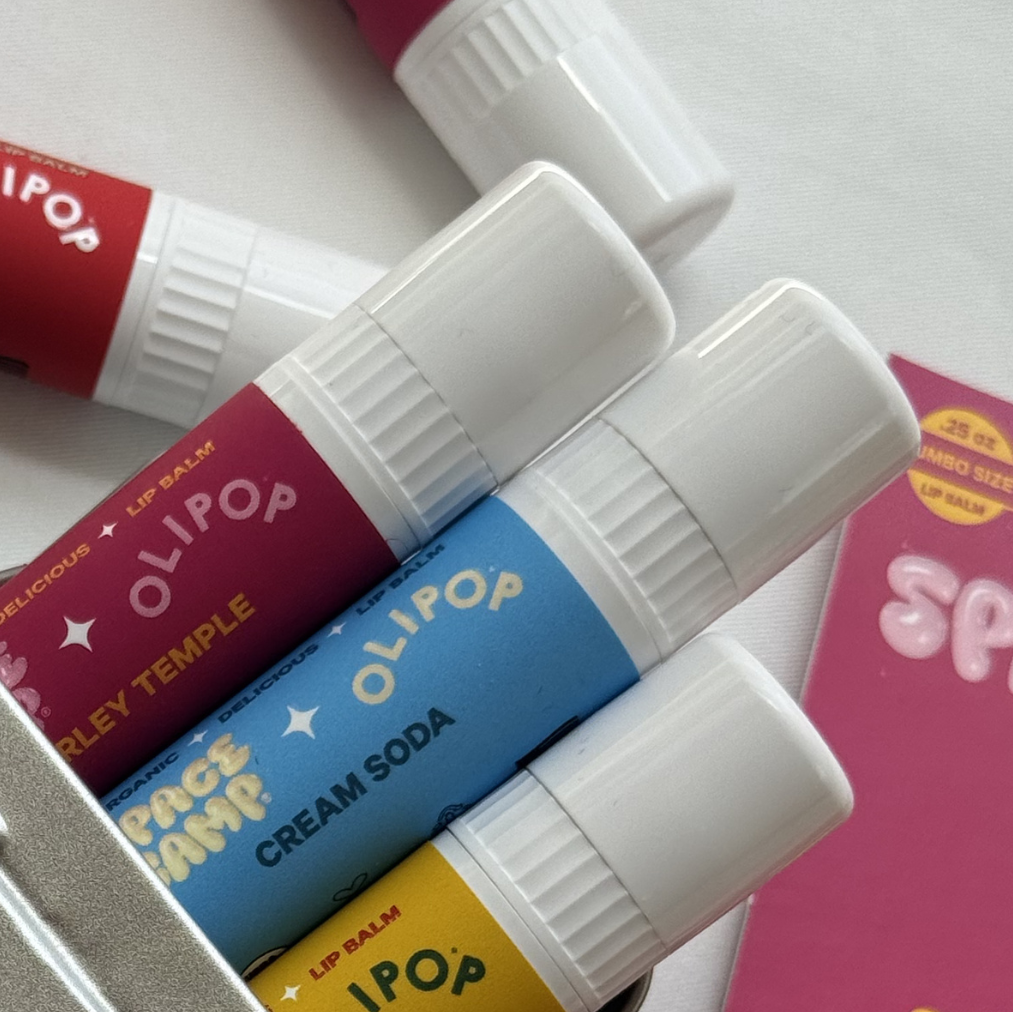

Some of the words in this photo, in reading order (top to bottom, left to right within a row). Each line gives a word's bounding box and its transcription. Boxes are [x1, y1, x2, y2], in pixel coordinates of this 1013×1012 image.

[125, 488, 156, 517] LIP
[158, 441, 216, 490] BALM
[129, 479, 297, 618] OLIPOP
[131, 592, 257, 696] TEMPLE
[217, 642, 320, 724] DELICIOUS
[356, 589, 386, 615] LIP
[389, 544, 445, 590] BALM
[352, 569, 523, 705] OLIPOP
[255, 771, 367, 868] CREAM
[363, 706, 456, 783] SODA
[308, 951, 341, 981] LIP
[342, 904, 402, 954] BALM
